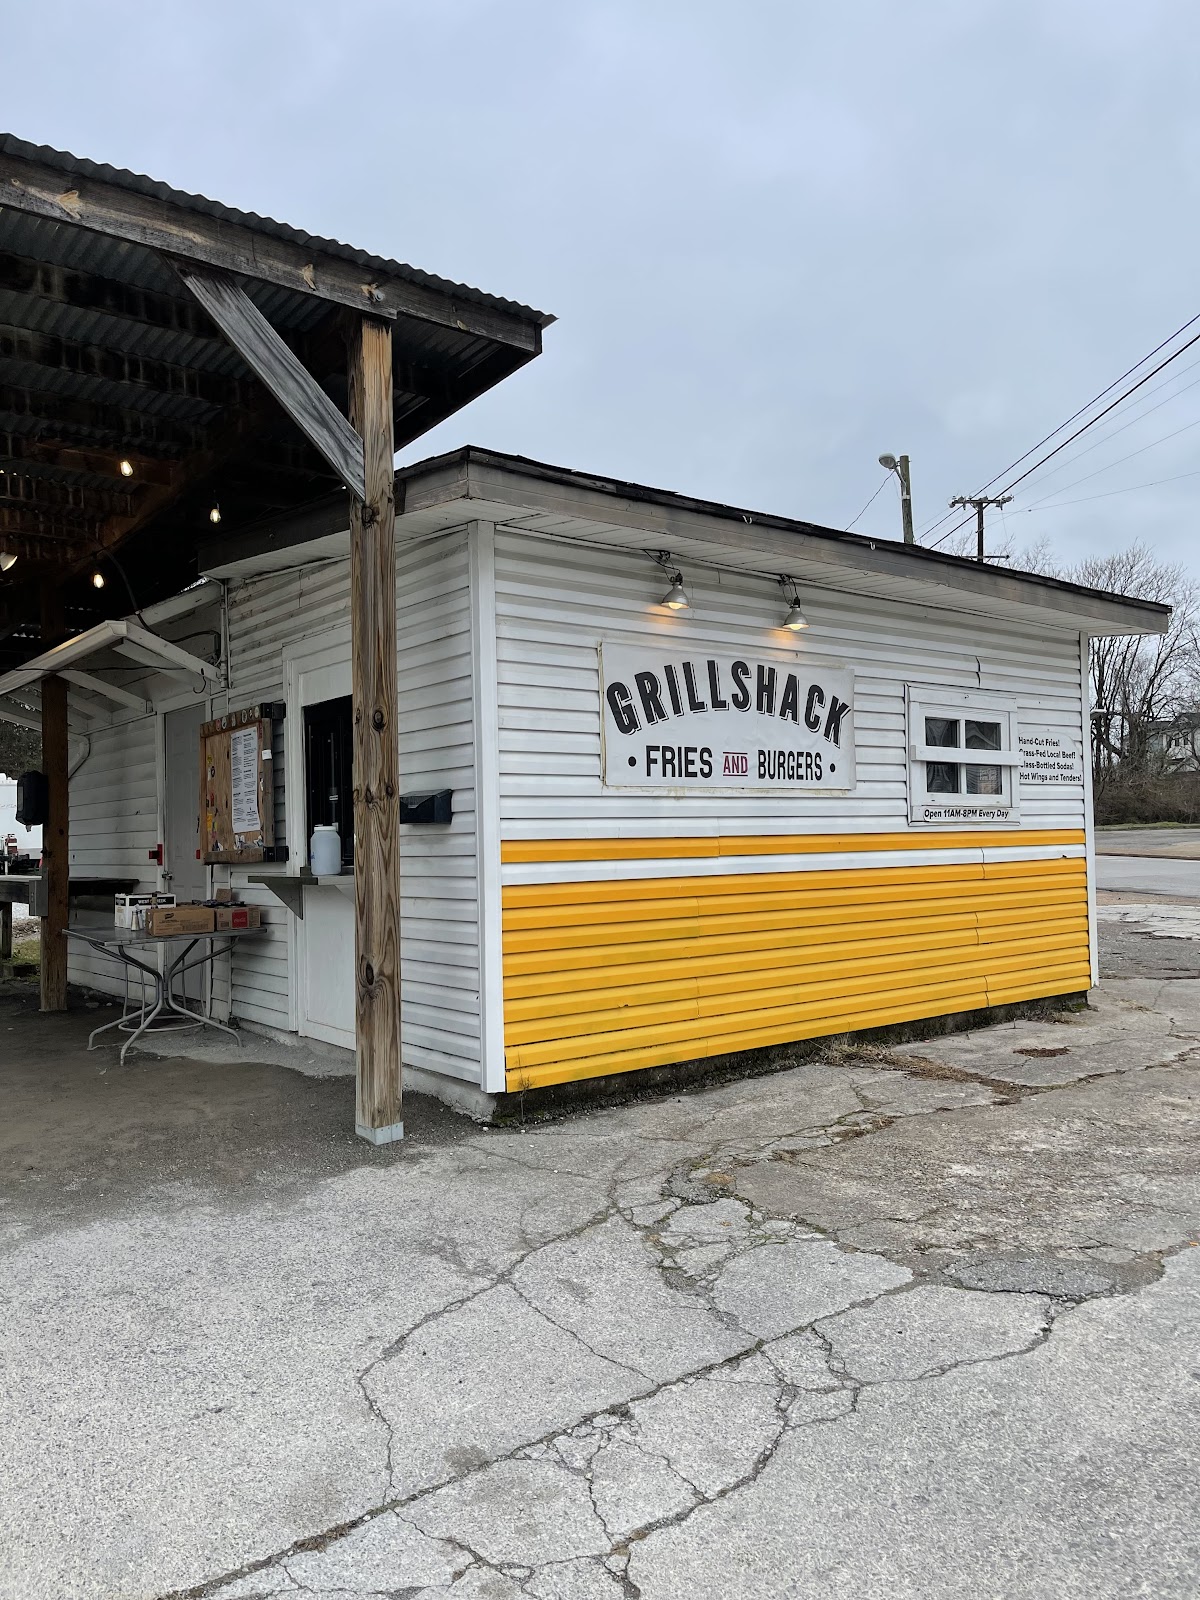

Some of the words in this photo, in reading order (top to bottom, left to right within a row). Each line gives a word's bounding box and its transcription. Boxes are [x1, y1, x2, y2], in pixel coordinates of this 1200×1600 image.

[606, 660, 851, 749] GRILLSHACK
[1018, 736, 1045, 747] Hand-Cut
[1045, 738, 1060, 747] Fries!
[1047, 750, 1061, 759] Local
[1062, 751, 1076, 759] Beef!
[646, 745, 713, 779] FRIES
[723, 752, 748, 777] AND
[758, 750, 823, 781] BURGERS
[1020, 760, 1056, 769] lass-Bottled
[1056, 762, 1075, 770] Sodas!
[1019, 772, 1030, 780] Hot
[1030, 772, 1048, 782] Wings
[1060, 774, 1082, 782] Tenders!
[924, 809, 942, 819] Open
[943, 809, 978, 818] 11AM-8PM
[978, 810, 995, 819] Every
[996, 810, 1009, 819] Day
